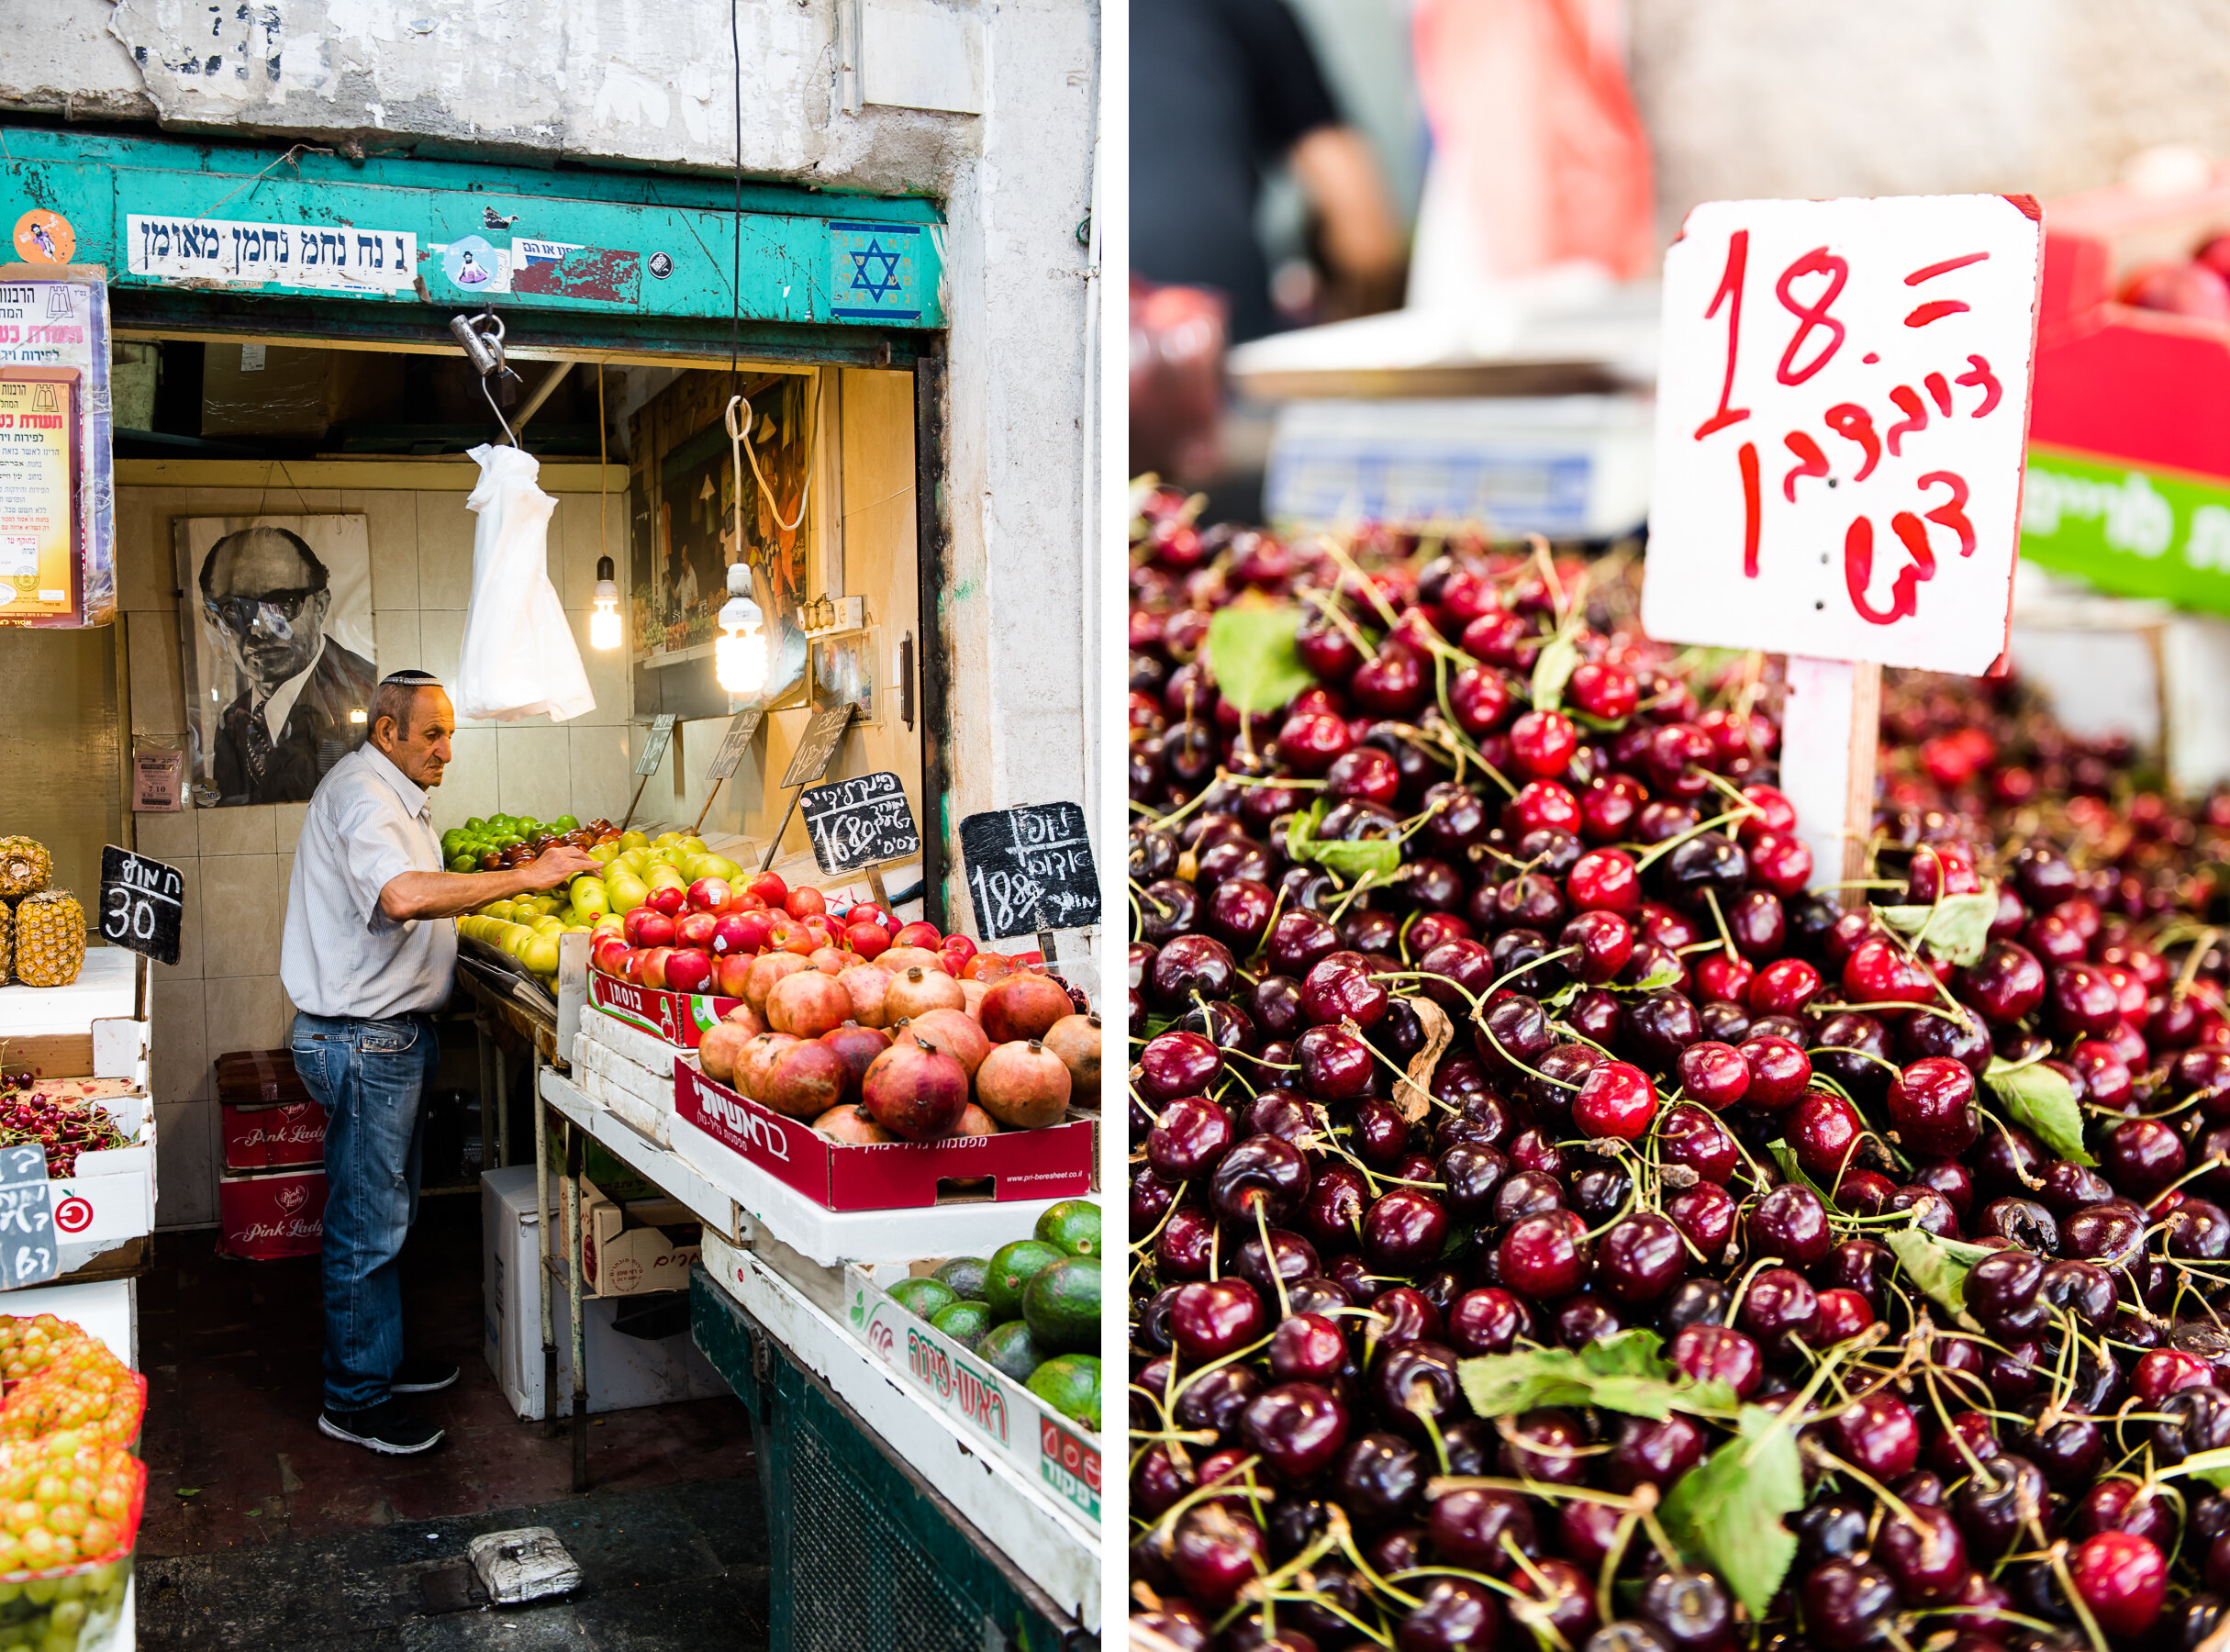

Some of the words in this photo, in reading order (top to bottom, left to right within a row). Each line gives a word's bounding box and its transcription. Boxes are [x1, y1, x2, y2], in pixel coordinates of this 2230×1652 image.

[141, 220, 219, 271] מאומן
[522, 241, 541, 253] הם
[541, 244, 555, 255] או
[19, 414, 62, 429] תעודת
[14, 432, 44, 442] לפירות
[105, 887, 156, 941] 30
[233, 1126, 288, 1146] Pink
[1007, 1170, 1083, 1183] www.pri-beresheet.co.il
[230, 1220, 287, 1243] Pink
